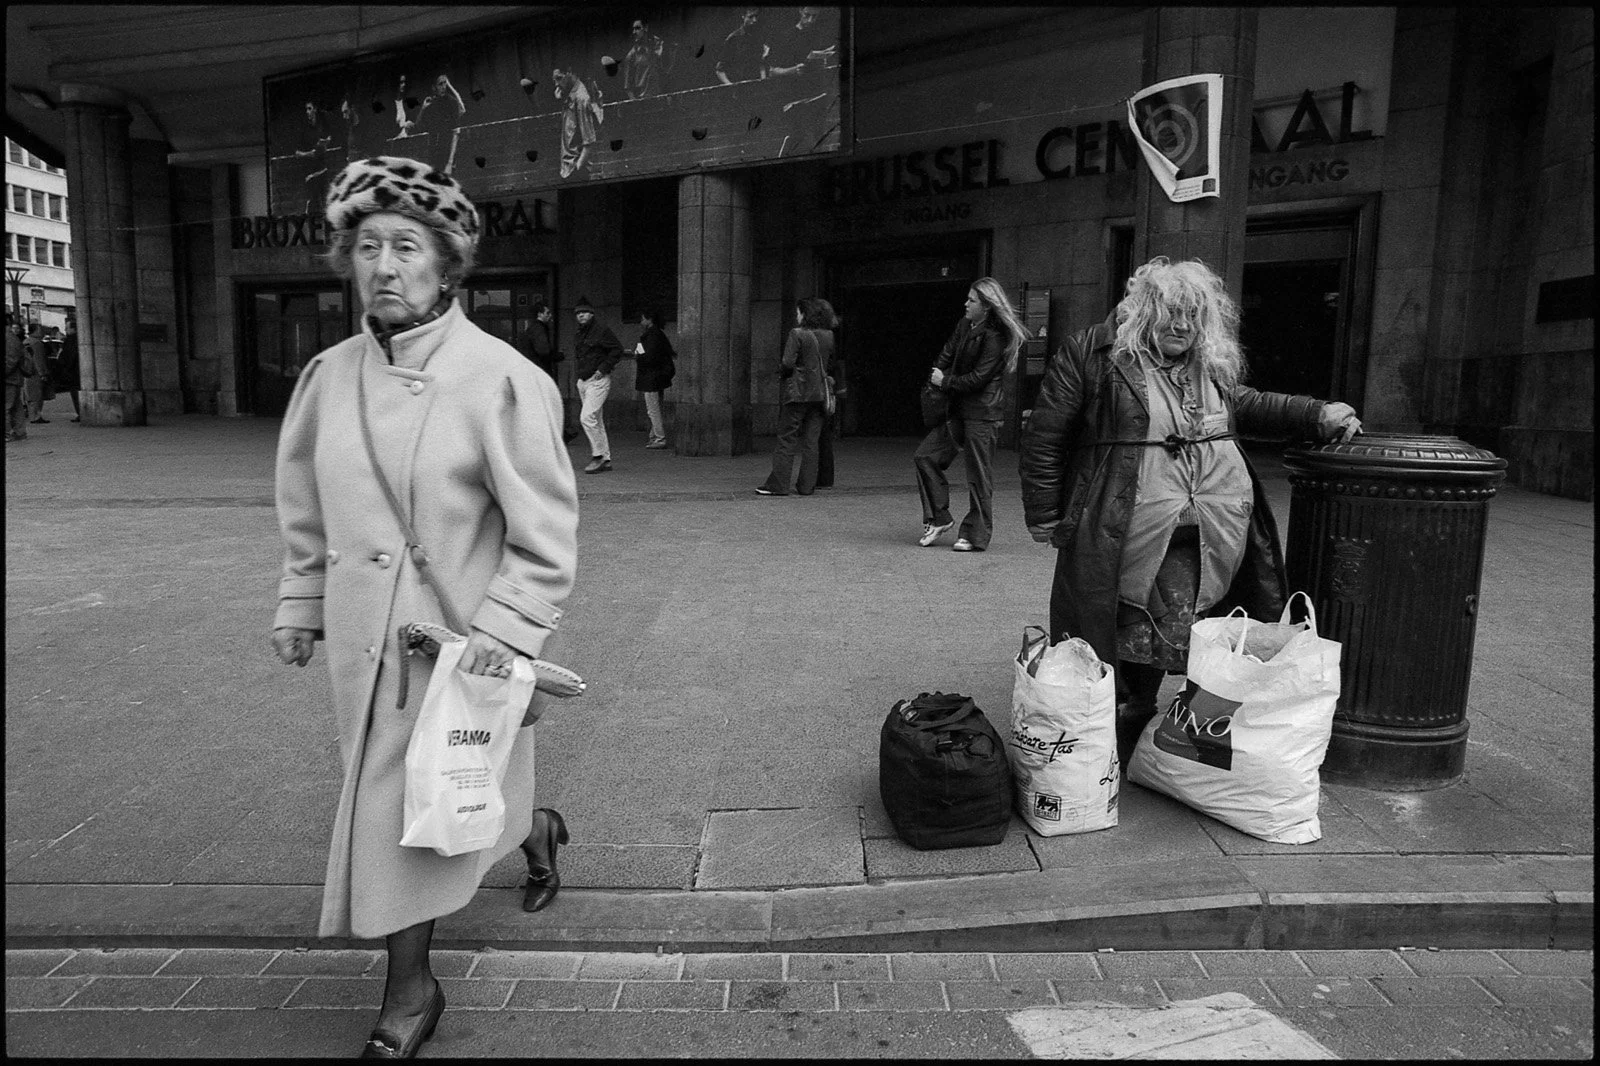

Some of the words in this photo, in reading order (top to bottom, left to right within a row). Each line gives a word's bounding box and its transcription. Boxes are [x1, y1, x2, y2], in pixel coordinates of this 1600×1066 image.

[827, 139, 1010, 206] BRUSSEL
[1248, 160, 1350, 191] NGANG
[1166, 695, 1233, 737] NNO
[1049, 731, 1079, 762] tas
